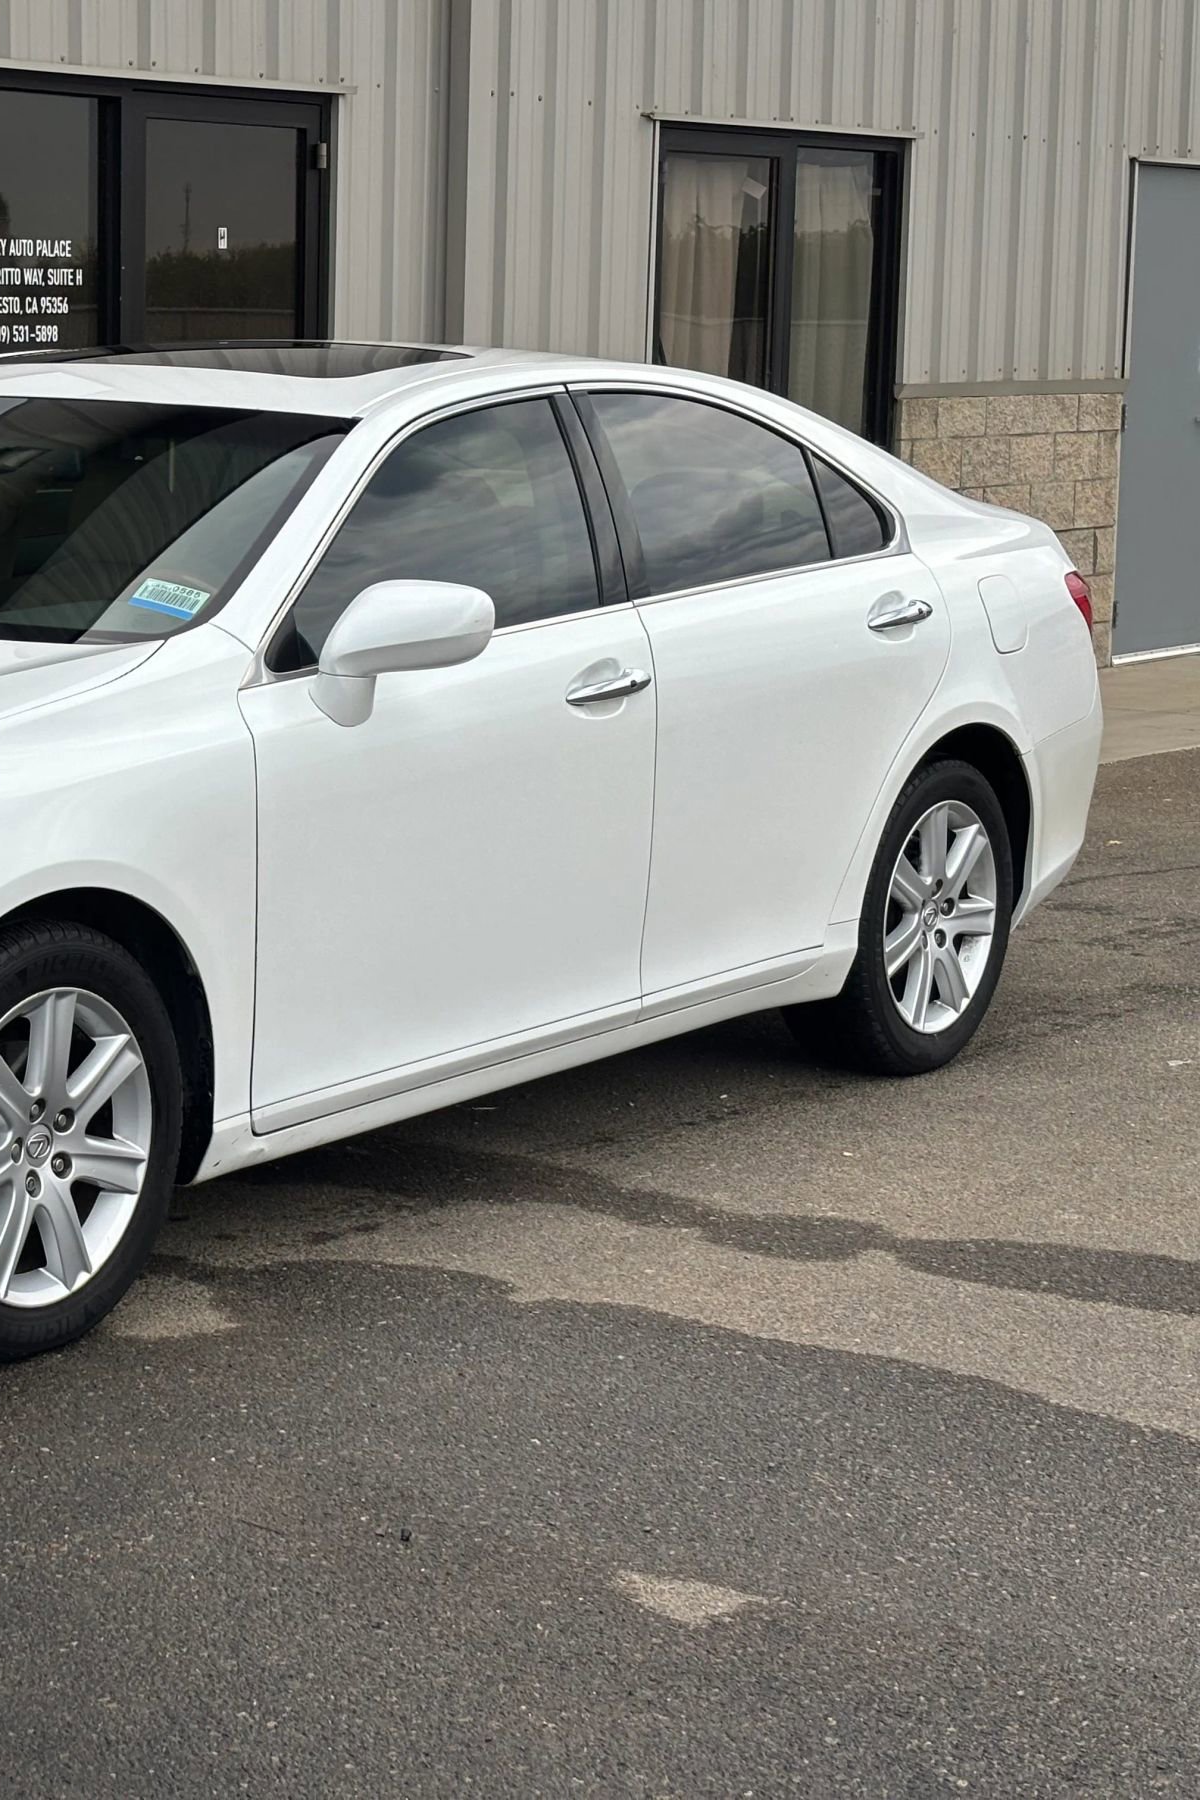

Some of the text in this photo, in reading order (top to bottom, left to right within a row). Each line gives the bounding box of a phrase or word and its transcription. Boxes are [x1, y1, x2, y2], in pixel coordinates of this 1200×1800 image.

[9, 239, 33, 257] AUTO
[36, 239, 72, 257] PALACE
[24, 268, 45, 286] WAY,
[47, 268, 74, 286] SUITE
[76, 268, 82, 286] H
[25, 297, 38, 314] CA
[41, 297, 69, 314] 95356
[12, 325, 58, 343] 531-5898
